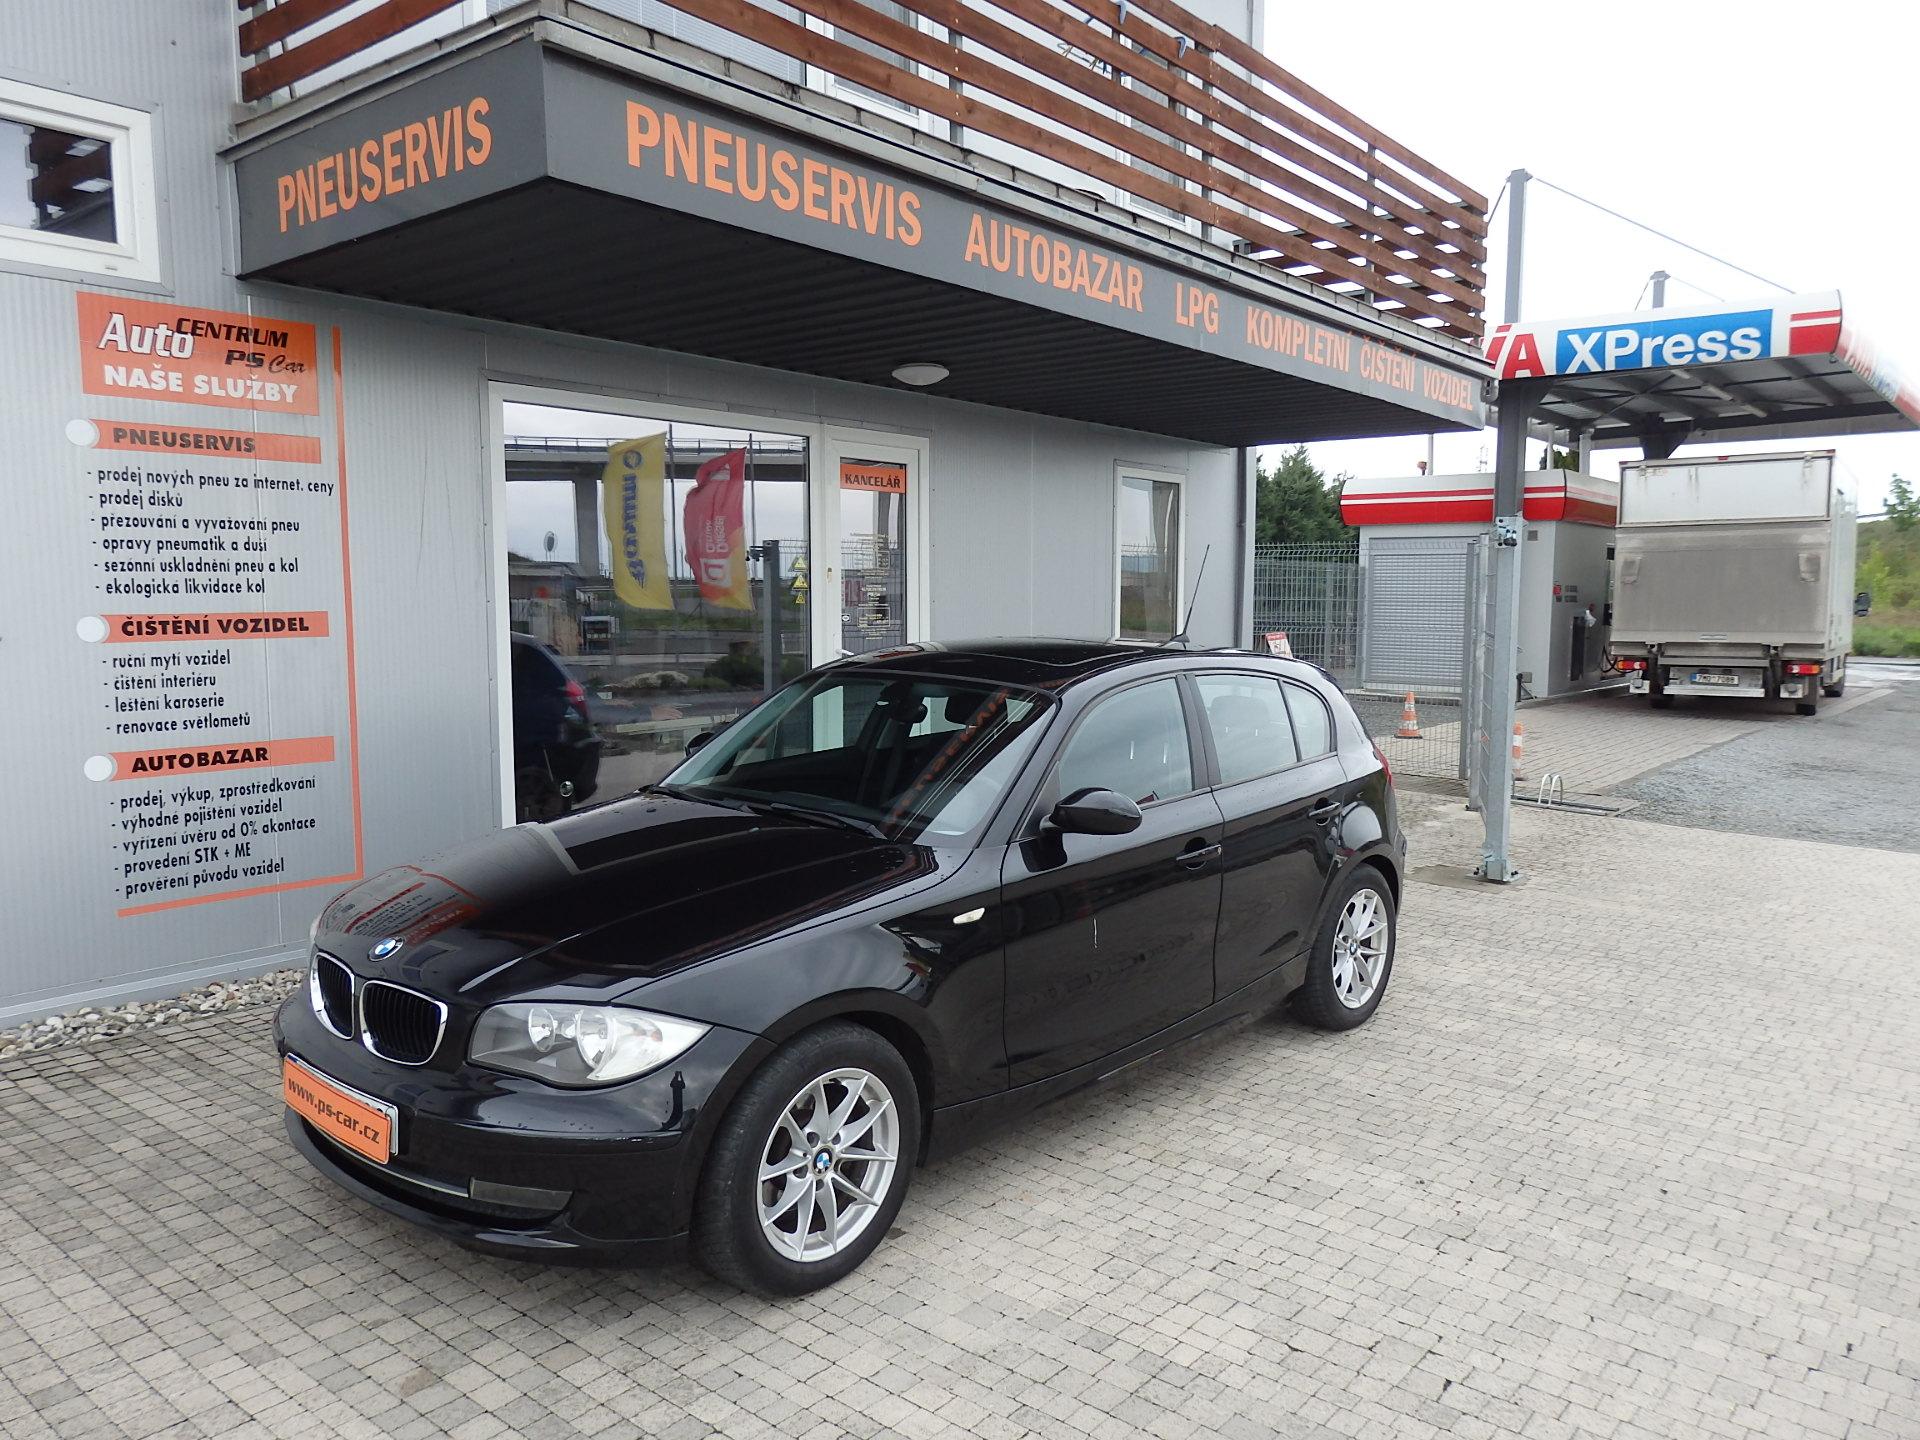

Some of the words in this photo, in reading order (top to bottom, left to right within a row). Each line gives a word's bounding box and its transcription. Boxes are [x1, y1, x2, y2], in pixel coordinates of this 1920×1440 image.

[277, 97, 492, 232] PNEUSERVIS
[626, 100, 922, 247] PNEUSERVIS
[964, 213, 1143, 312] AUTOBAZAR
[1175, 282, 1219, 334] LPG
[1247, 305, 1352, 373] KOMPLETNÍ
[1359, 336, 1416, 392] ČIŠTĚNÍ
[1423, 366, 1473, 410] VOZIDEL
[97, 312, 195, 359] Auto
[176, 317, 288, 348] CENTRUM
[225, 350, 266, 368] PS
[268, 355, 306, 374] Car
[1565, 327, 1762, 374] XPress
[104, 363, 184, 392] NAŠE
[194, 374, 298, 403] SLUŽBY
[113, 428, 256, 453] PNEUSERVIS
[98, 466, 142, 487] prodej
[147, 469, 193, 488] nových
[200, 475, 229, 490] pneu
[234, 476, 248, 488] za
[307, 481, 334, 496] ceny
[845, 474, 900, 488] KANCELÁŘ
[100, 492, 143, 509] prodej
[101, 515, 176, 531] přezouvání
[182, 518, 189, 529] a
[195, 516, 267, 534] vyvažování
[271, 520, 300, 535] pneu
[103, 539, 151, 551] opravy
[157, 537, 226, 553] pneumatik
[231, 541, 238, 551] a
[160, 557, 230, 573] uskladnění
[235, 562, 264, 575] pneu
[268, 562, 276, 573] a
[280, 557, 298, 572] kol
[184, 578, 242, 594] likvidace
[247, 578, 265, 594] kol
[122, 615, 210, 637] ČIŠTĚNÍ
[217, 617, 309, 634] VOZIDEL
[113, 654, 146, 668] ruční
[151, 652, 181, 670] mytí
[185, 649, 231, 666] vozidel
[114, 675, 157, 691] čištění
[161, 674, 216, 689] interiéru
[165, 692, 225, 710] karoserie
[116, 720, 178, 735] renovace
[131, 748, 269, 772] AUTOBAZAR
[219, 776, 316, 799] zprostředkování
[122, 811, 179, 834] výhodné
[240, 798, 283, 816] vozidel
[221, 823, 236, 840] od
[241, 820, 258, 837] 0%
[262, 816, 316, 834] akontace
[124, 854, 190, 878] provedení
[194, 846, 219, 864] STK
[235, 842, 252, 857] ME
[193, 867, 238, 888] původu
[242, 858, 285, 877] vozidel
[288, 1078, 380, 1144] www.ps-car.cz
